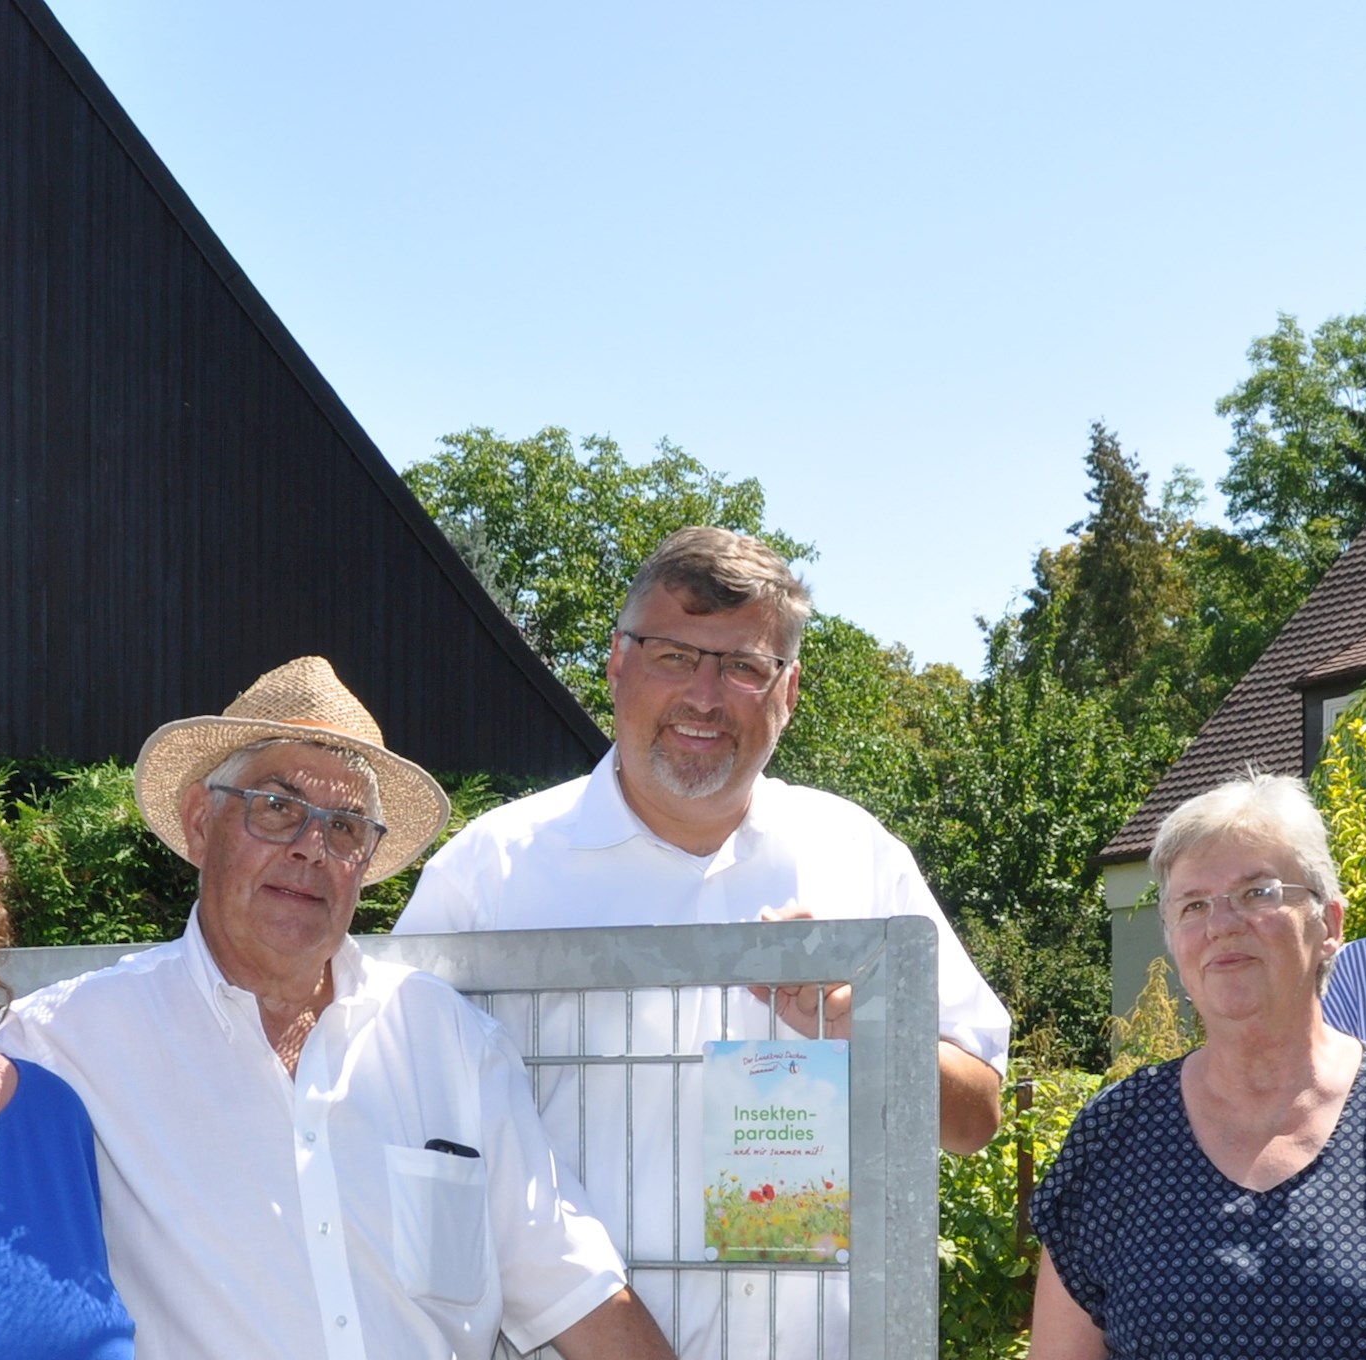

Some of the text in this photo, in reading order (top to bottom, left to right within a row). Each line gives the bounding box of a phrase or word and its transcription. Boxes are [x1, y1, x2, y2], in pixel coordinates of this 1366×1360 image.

[734, 1104, 817, 1121] Insekten-
[734, 1124, 814, 1145] paradies
[733, 1146, 752, 1156] und
[769, 1148, 802, 1157] summen
